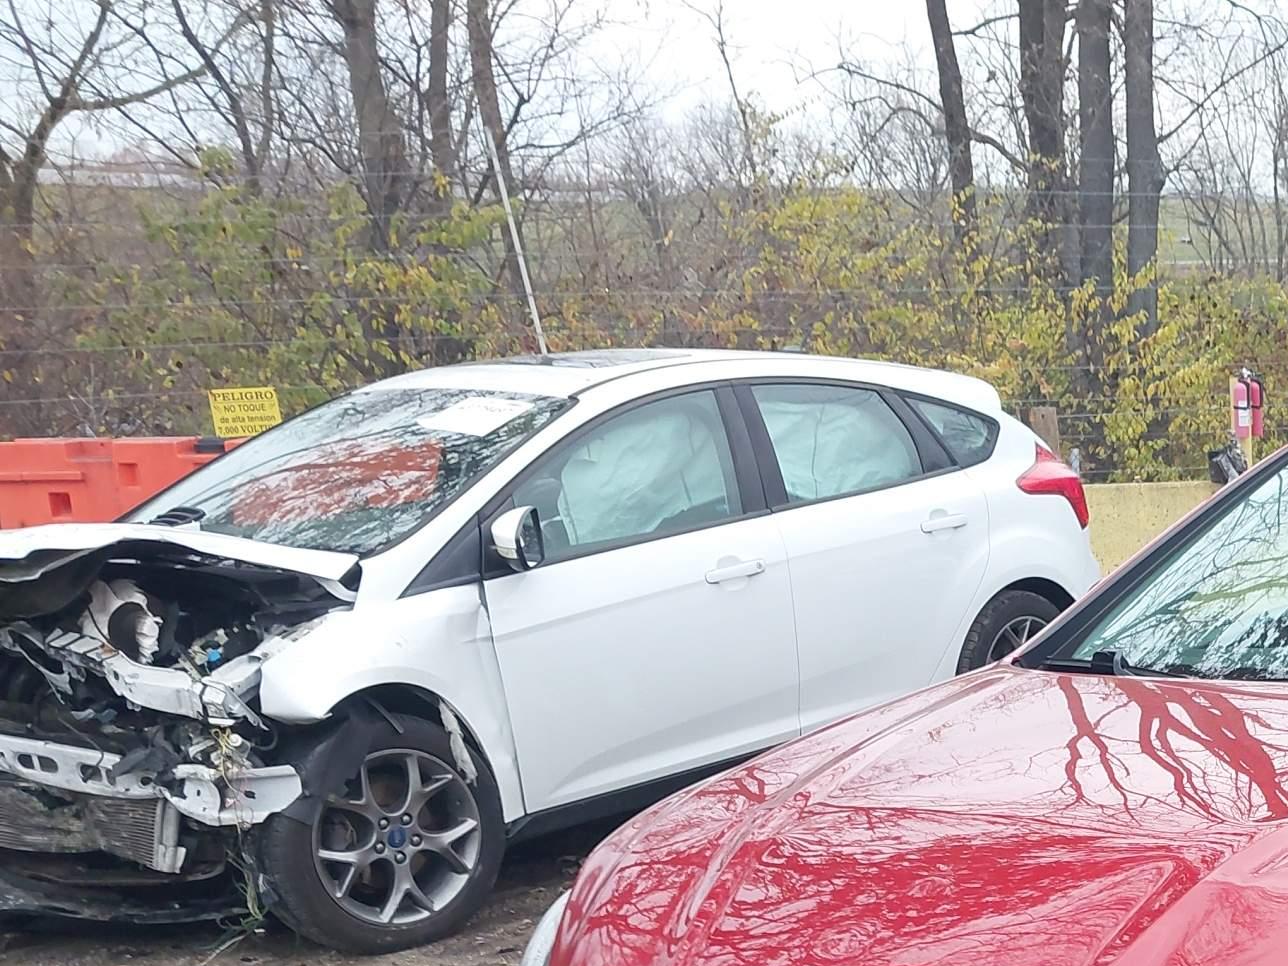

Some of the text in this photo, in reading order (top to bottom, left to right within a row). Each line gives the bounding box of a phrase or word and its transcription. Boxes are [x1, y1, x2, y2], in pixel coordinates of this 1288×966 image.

[213, 391, 274, 402] PELIGRO
[224, 403, 267, 414] NO TOQUE
[246, 415, 276, 423] tension
